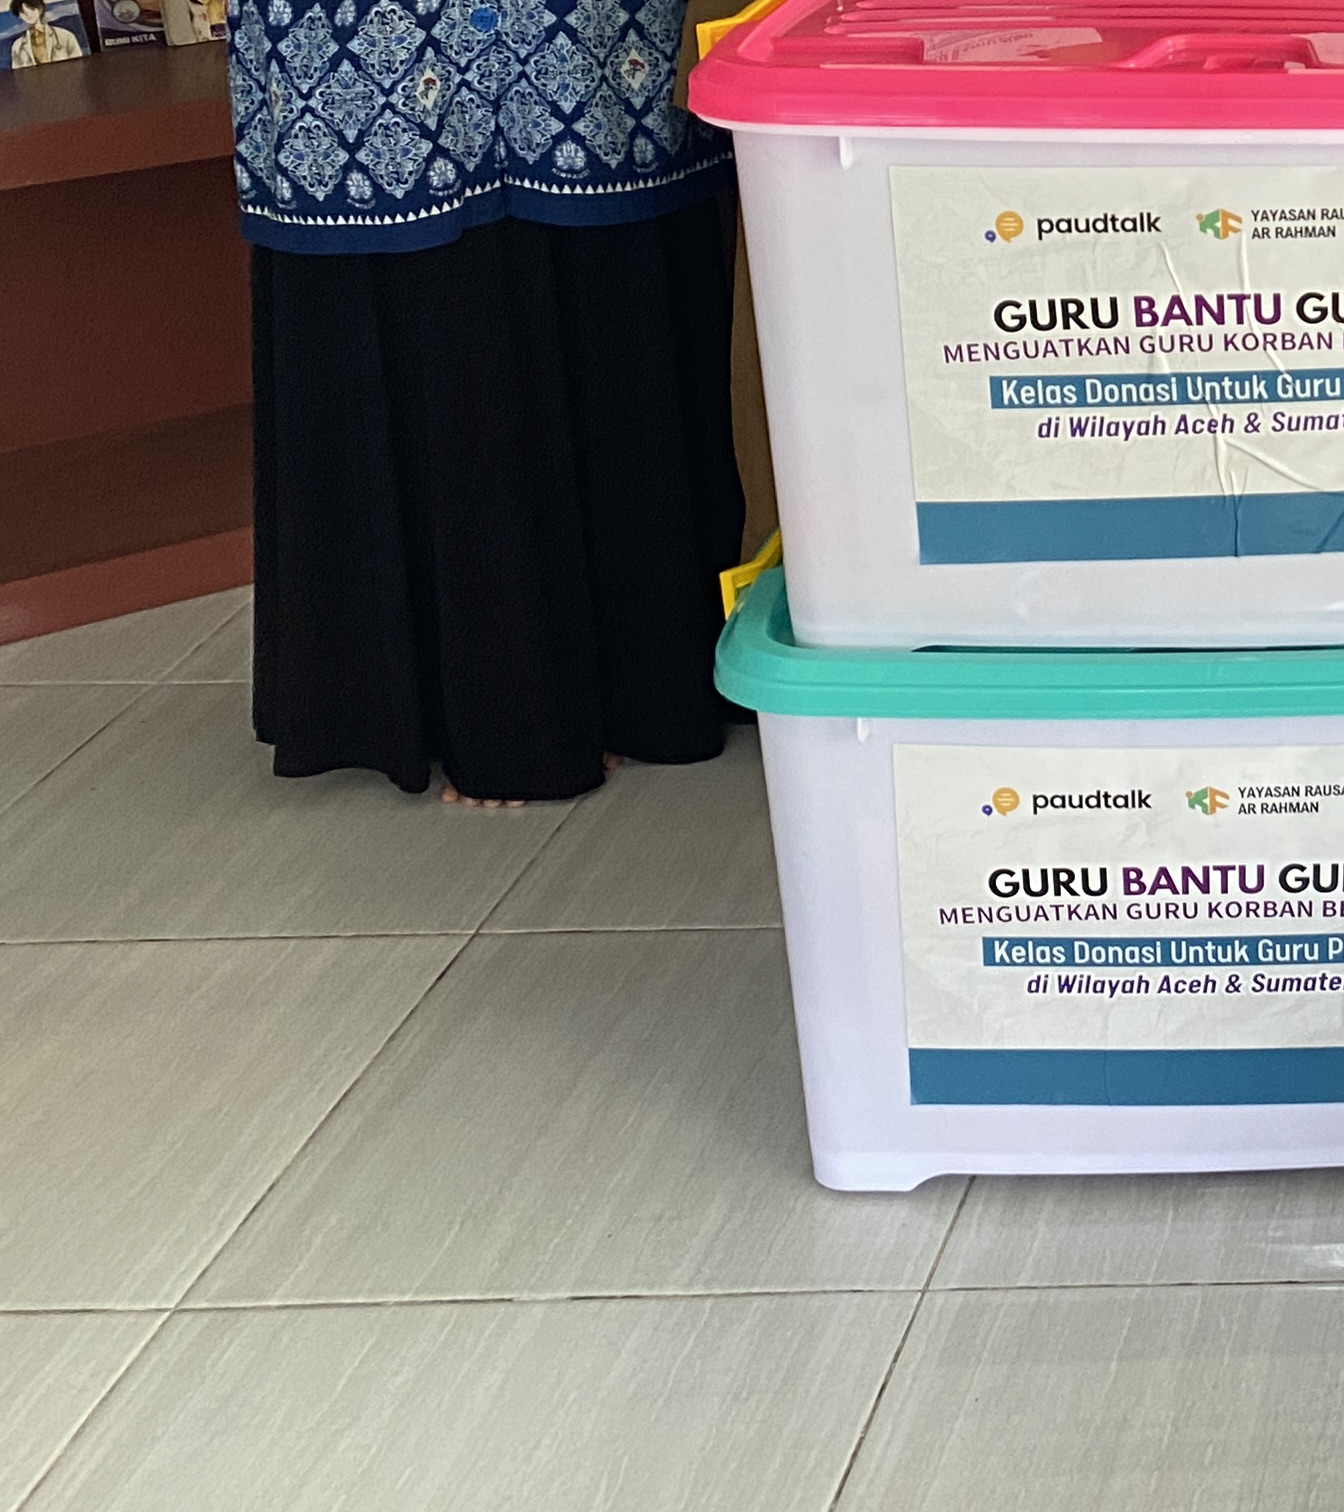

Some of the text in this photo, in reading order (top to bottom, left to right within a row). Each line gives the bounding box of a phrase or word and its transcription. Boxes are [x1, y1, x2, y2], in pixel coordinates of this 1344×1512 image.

[1037, 212, 1162, 240] paudtalk
[1251, 208, 1316, 222] YAYASAN
[1252, 224, 1336, 239] AR RAHMAN
[994, 298, 1120, 332] GURU
[1134, 294, 1282, 328] BANTU
[944, 338, 1130, 363] MENGUATKAN
[1140, 334, 1213, 354] GURU
[1224, 333, 1332, 352] KORBAN
[1002, 380, 1077, 405] Kelas
[1086, 377, 1178, 404] Donasi
[1186, 374, 1268, 400] Untuk
[1276, 372, 1340, 398] Guru
[1038, 416, 1060, 438] di
[1068, 416, 1166, 441] Wilayah
[1175, 413, 1234, 435] Aceh
[1244, 413, 1261, 432] &
[1032, 790, 1152, 814] paudtalk
[988, 867, 1108, 898] GURU
[1122, 865, 1265, 896] BANTU
